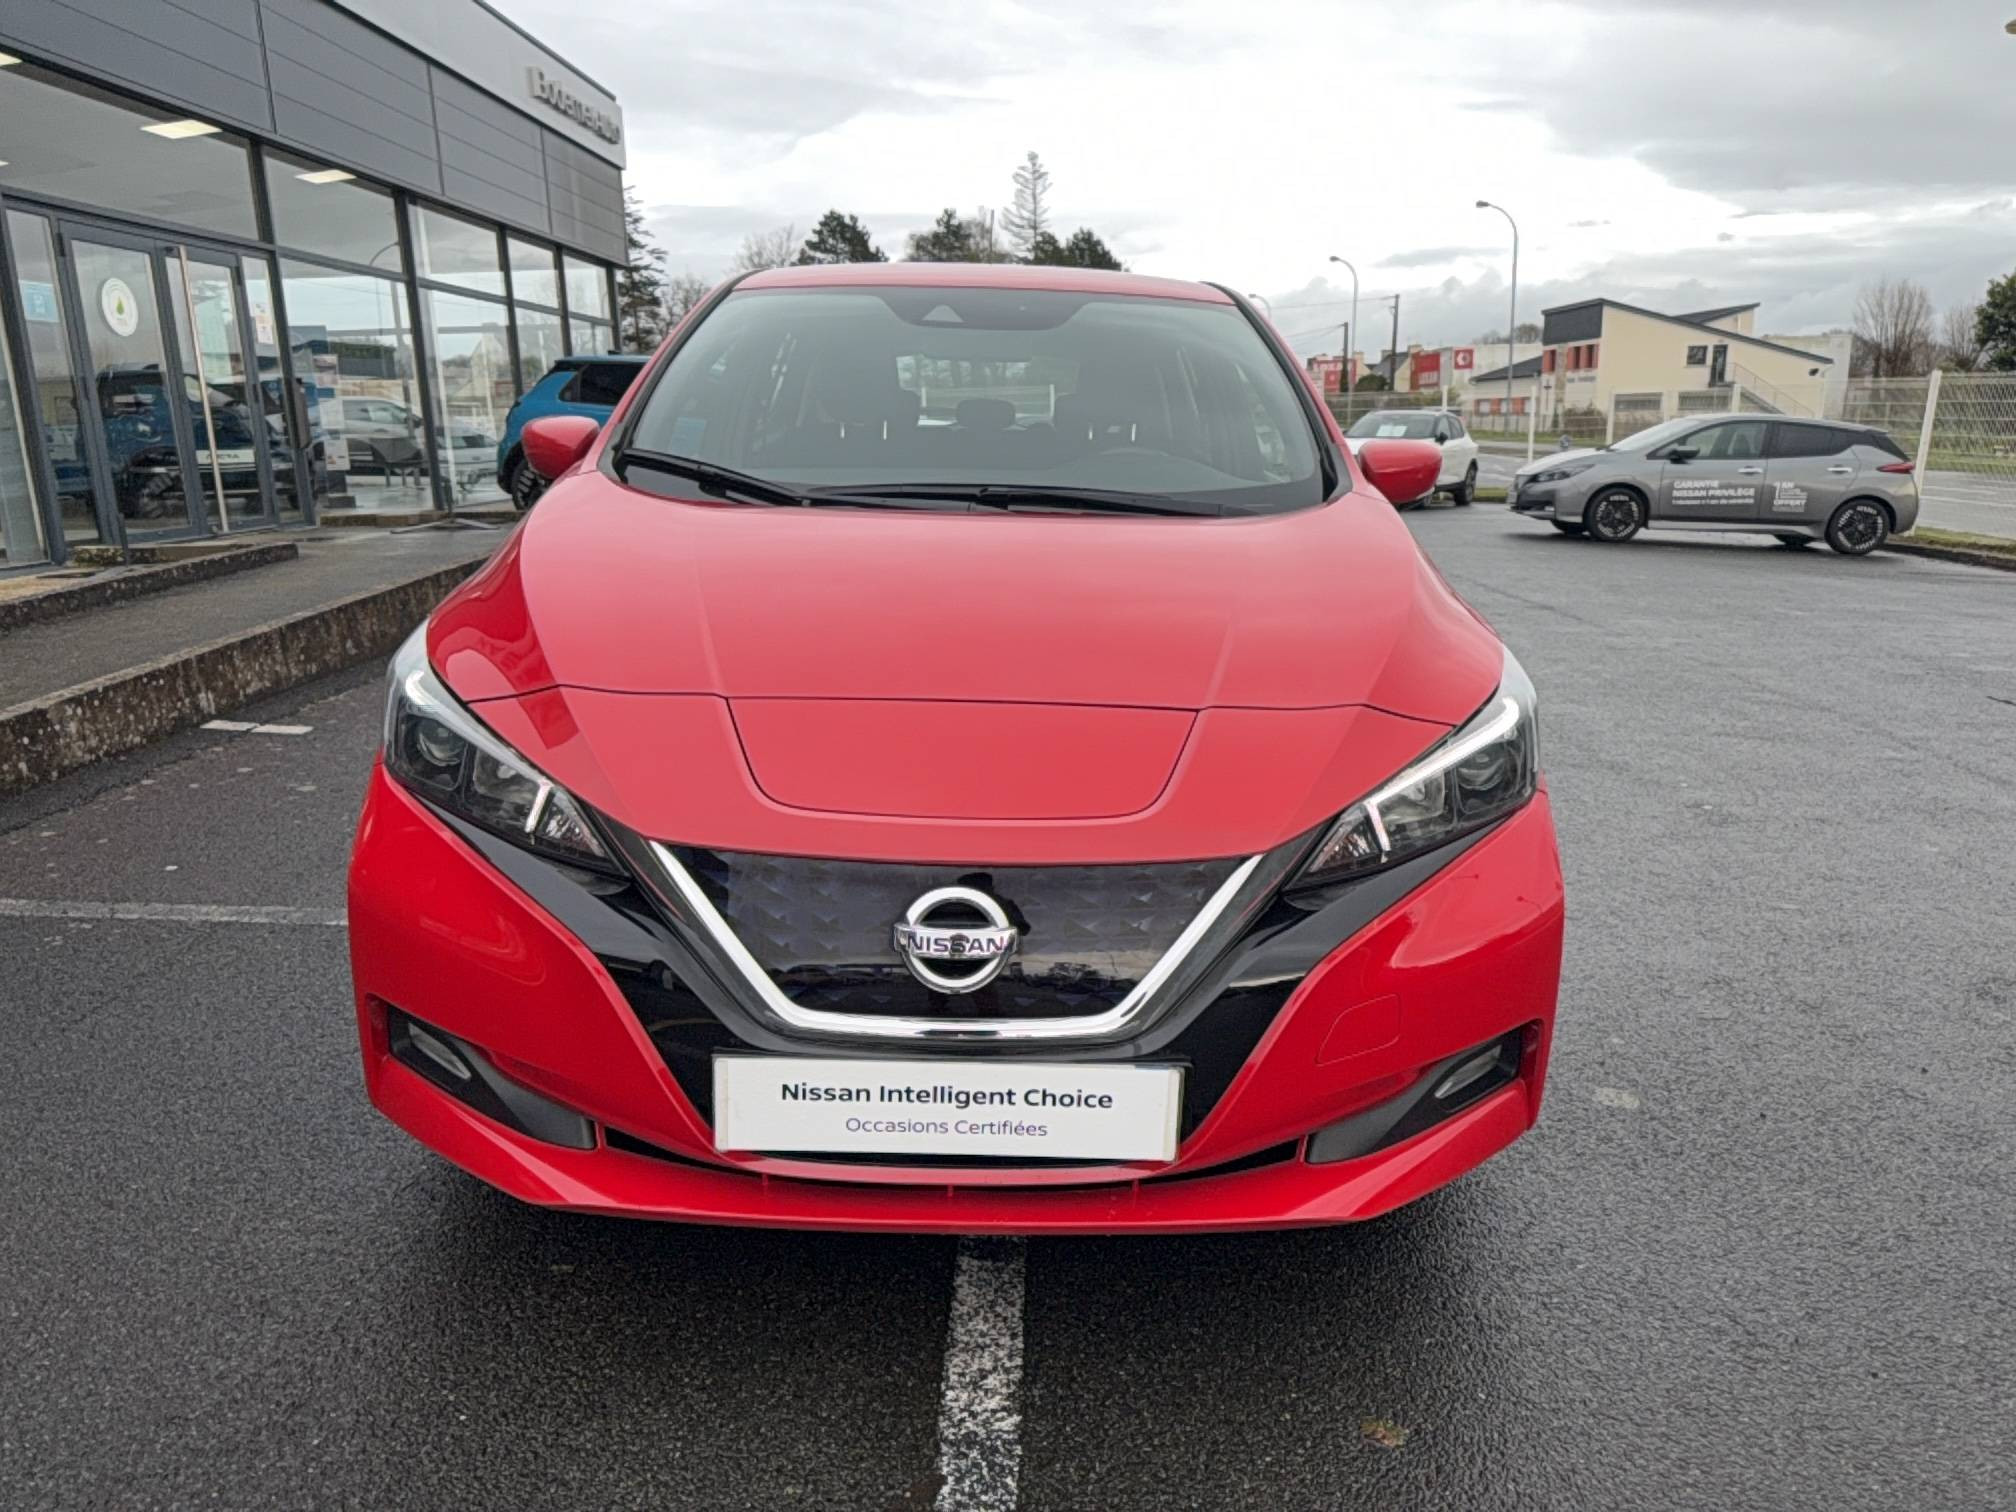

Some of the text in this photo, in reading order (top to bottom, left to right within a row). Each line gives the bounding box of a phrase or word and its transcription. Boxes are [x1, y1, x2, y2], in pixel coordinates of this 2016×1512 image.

[1672, 489, 1707, 497] NISSAN
[907, 932, 1004, 953] NISSAN
[782, 1082, 1113, 1109] Nissan Intelligent Choice
[846, 1118, 1047, 1136] Occasions Certifiées
